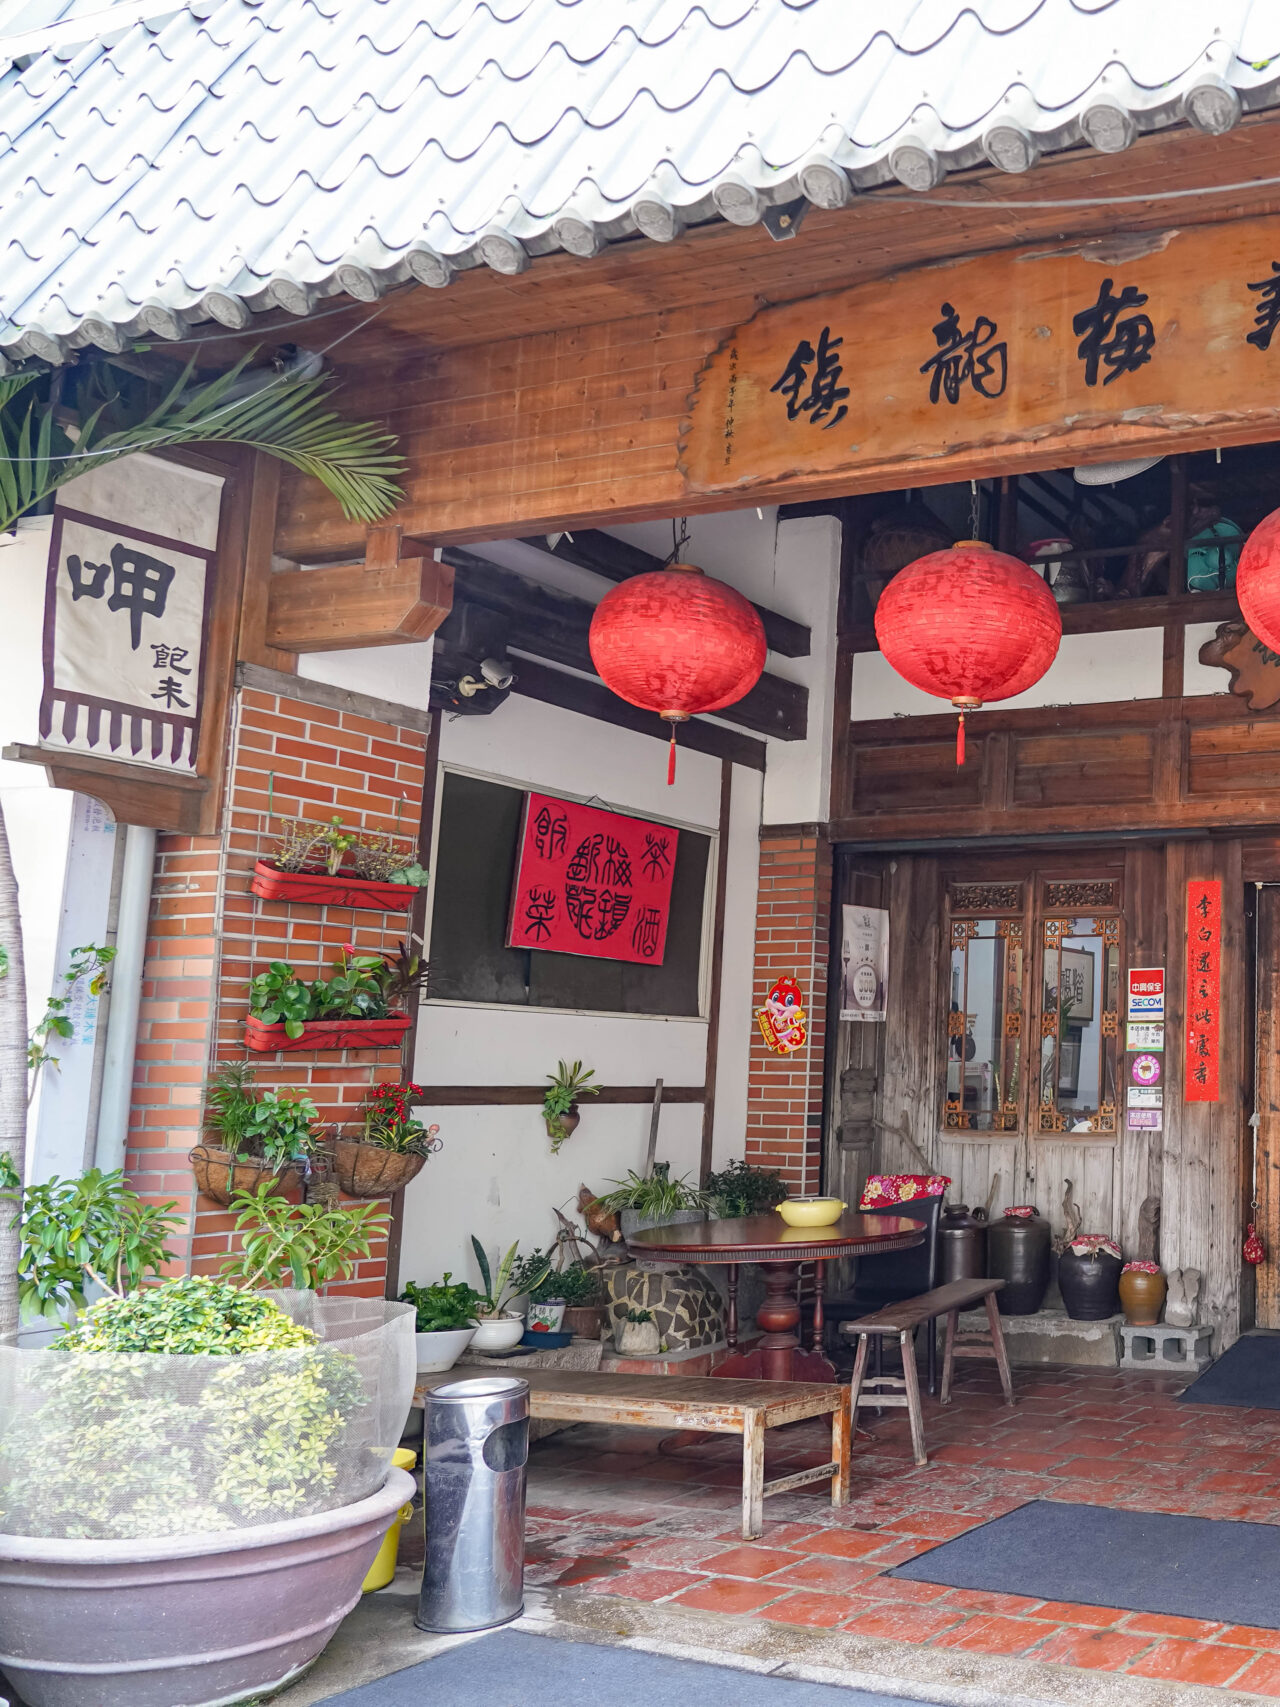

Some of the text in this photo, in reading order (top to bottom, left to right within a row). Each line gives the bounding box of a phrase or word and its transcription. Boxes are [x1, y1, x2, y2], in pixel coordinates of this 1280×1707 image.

[66, 543, 176, 651] 呷
[150, 643, 192, 709] 飽未
[1131, 982, 1162, 993] 中興保全
[1131, 997, 1162, 1007] SECOM
